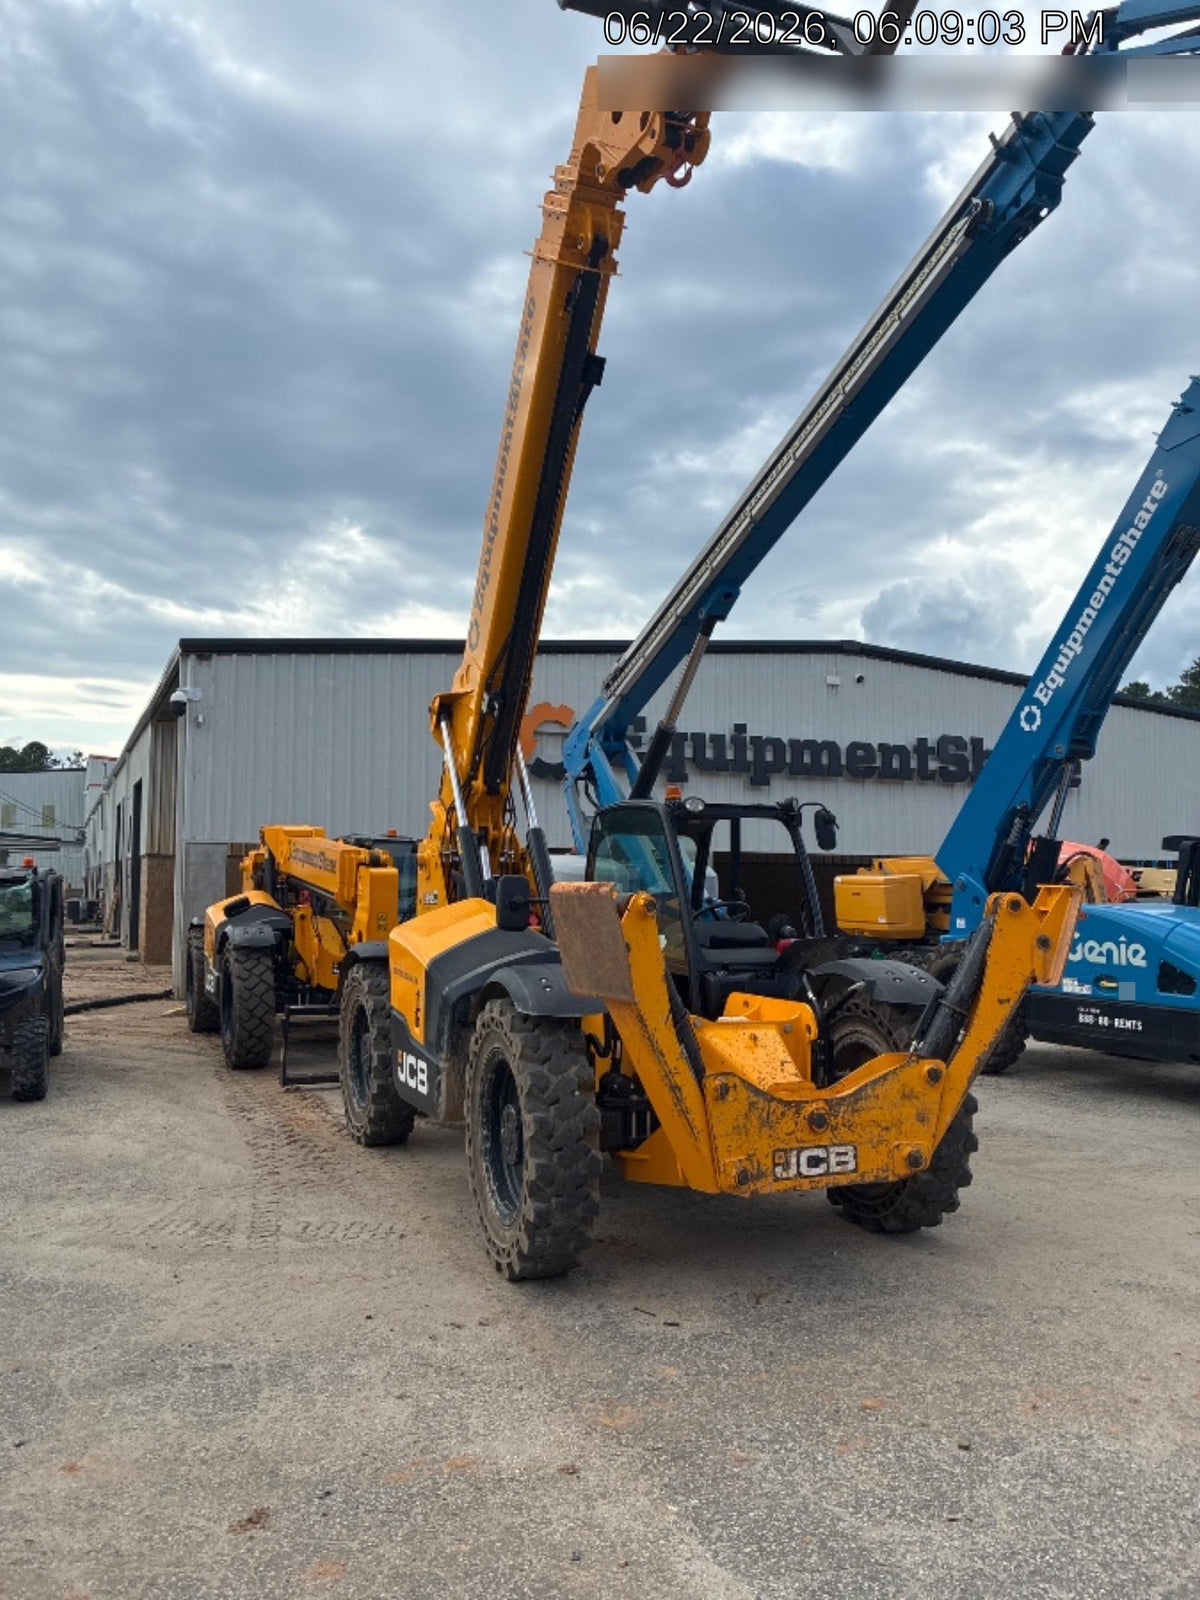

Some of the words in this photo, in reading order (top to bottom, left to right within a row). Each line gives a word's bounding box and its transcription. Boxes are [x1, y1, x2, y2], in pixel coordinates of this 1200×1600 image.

[1033, 478, 1169, 707] EquipmentShare
[396, 1050, 429, 1096] JCB
[774, 1145, 857, 1179] JCB
